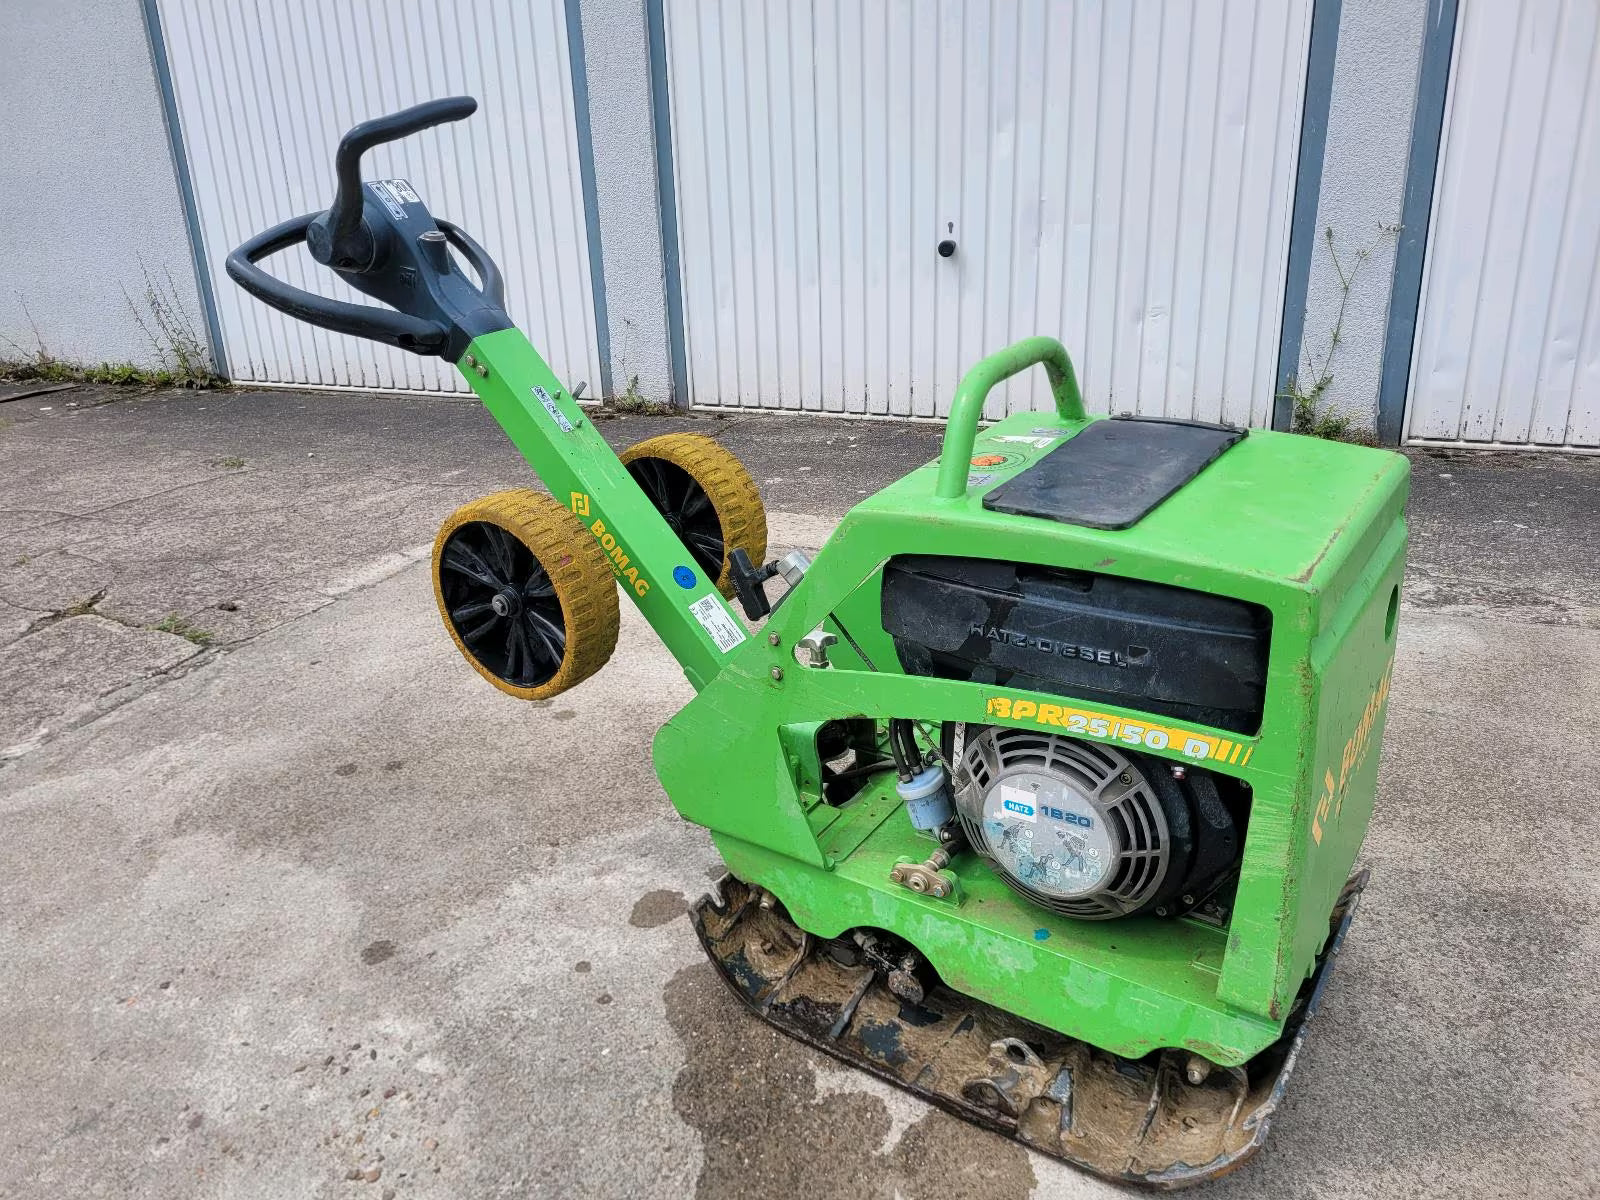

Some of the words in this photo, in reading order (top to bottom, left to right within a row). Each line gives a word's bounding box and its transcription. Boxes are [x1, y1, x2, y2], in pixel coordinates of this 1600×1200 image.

[591, 519, 649, 596] BOMAG
[969, 622, 1129, 669] HATZ-DIESEL
[986, 697, 1064, 727] BPR
[1067, 714, 1170, 750] 25/50
[1182, 737, 1210, 759] D
[1008, 802, 1030, 814] HATZ
